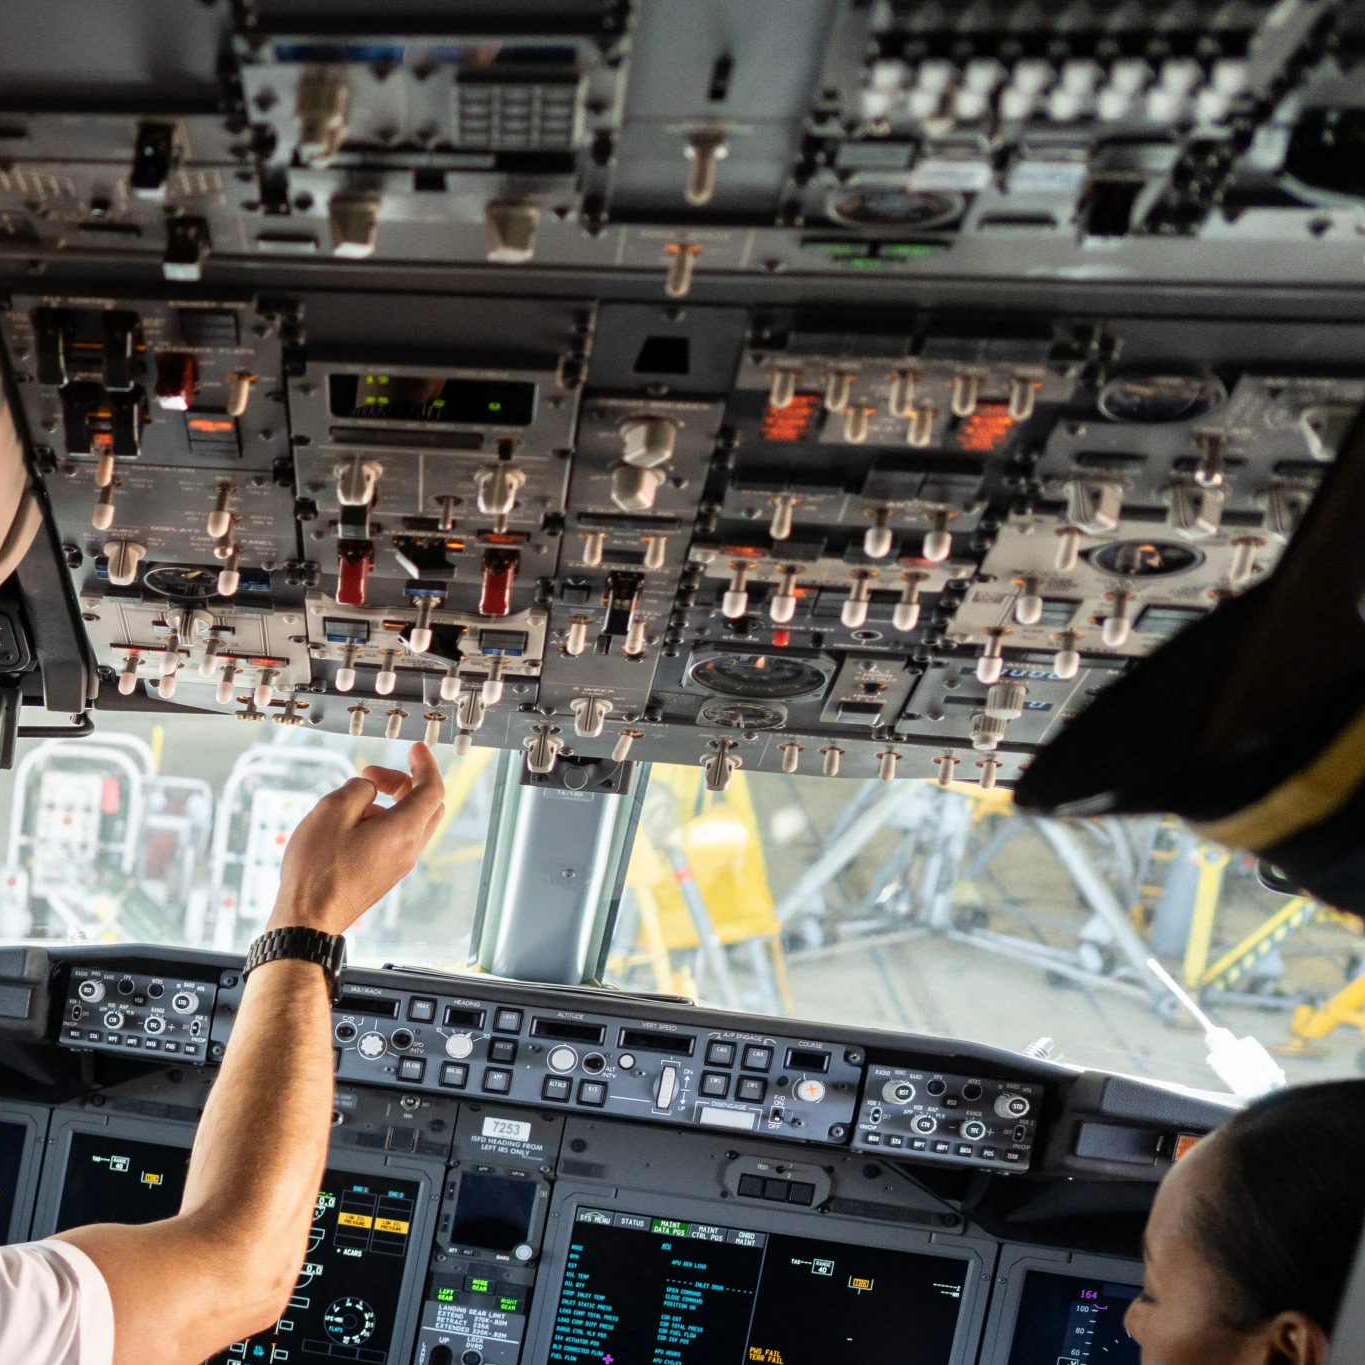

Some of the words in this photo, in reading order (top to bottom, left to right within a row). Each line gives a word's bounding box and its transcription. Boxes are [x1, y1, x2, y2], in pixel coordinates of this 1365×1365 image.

[557, 1012, 584, 1020] ALTITUDE
[712, 1101, 746, 1110] DISENGAGE
[493, 1121, 520, 1135] 7253
[488, 1138, 520, 1147] HEADING
[522, 1143, 543, 1151] FROM
[510, 1148, 530, 1156] ONLY
[594, 1216, 610, 1224] MENU
[621, 1218, 644, 1226] STATUS
[661, 1220, 680, 1229] MAINT
[654, 1226, 669, 1234] DATA
[699, 1226, 718, 1234] MAINT
[692, 1232, 707, 1240] CTRL
[711, 1234, 723, 1242] PGS
[736, 1238, 755, 1246] MAINT
[343, 1249, 362, 1257] ACARS
[1080, 1290, 1097, 1300] 164
[439, 1304, 466, 1313] LANDING
[1076, 1305, 1089, 1313] 100
[438, 1310, 463, 1319] EXTEND
[437, 1317, 467, 1325] RETRACT
[435, 1323, 470, 1332] EXTENDED
[1075, 1327, 1085, 1335] 80
[765, 1349, 781, 1357] FAIL
[768, 1356, 783, 1364] FAIL
